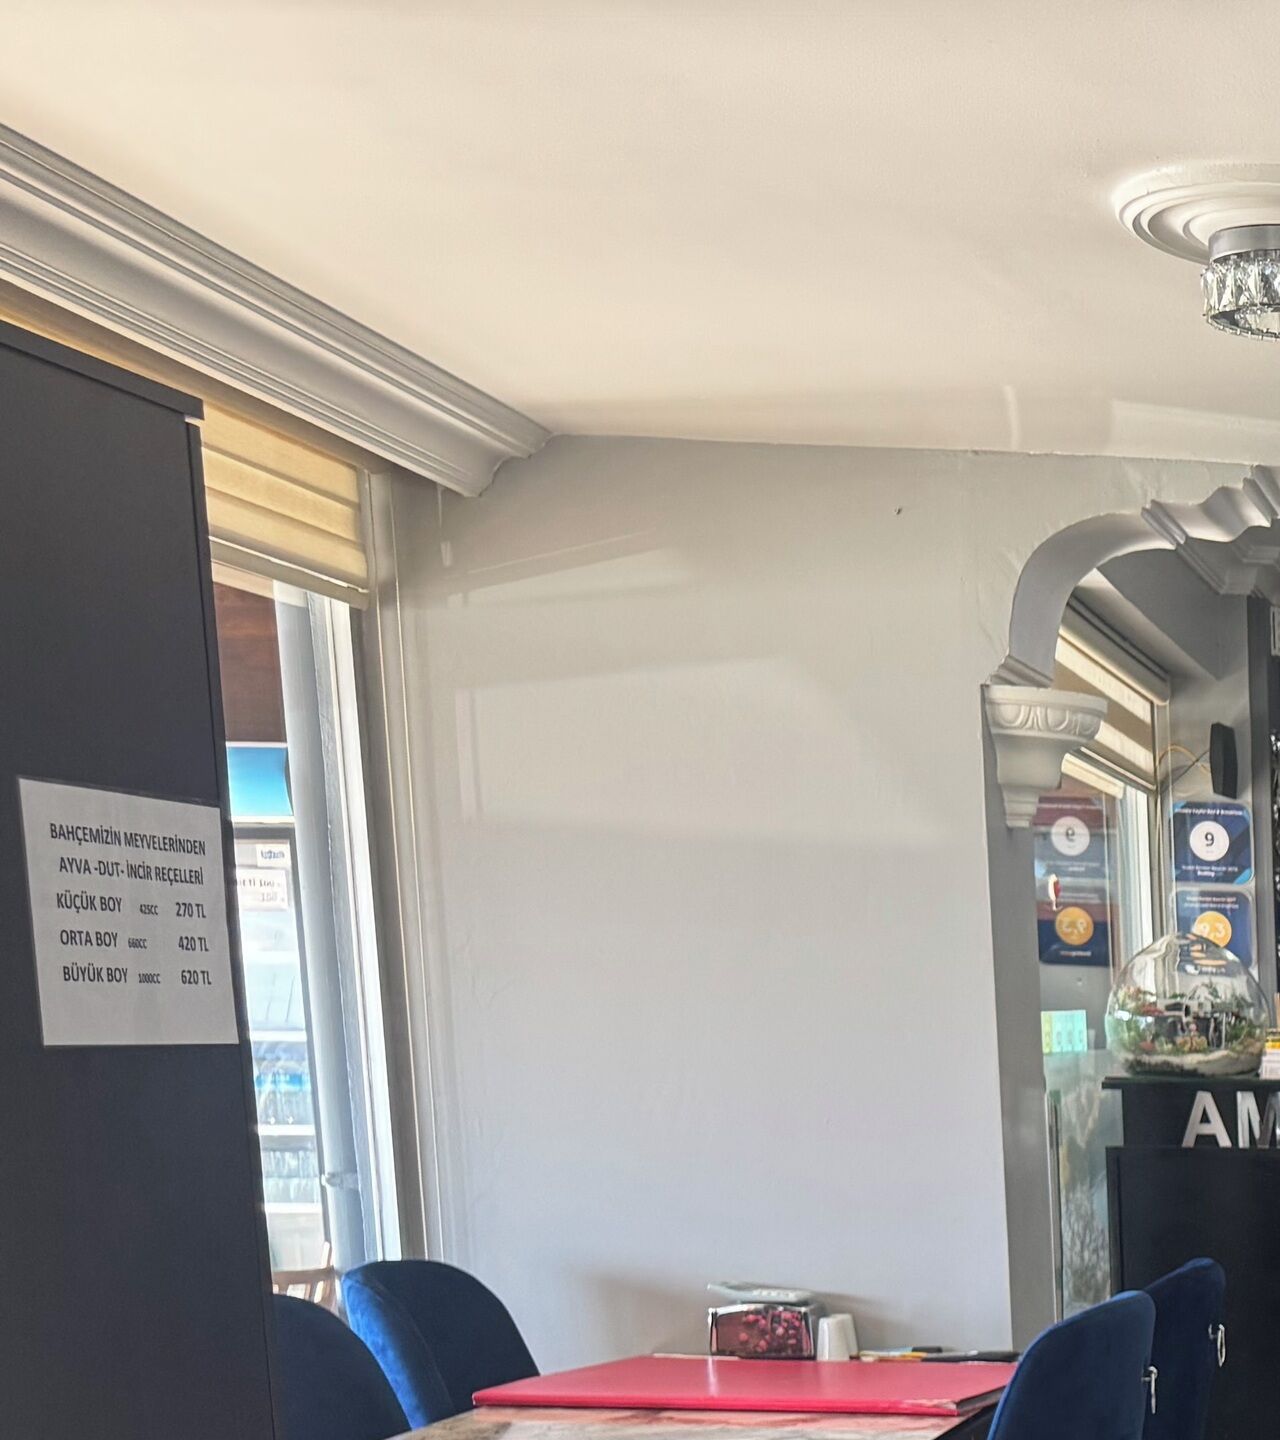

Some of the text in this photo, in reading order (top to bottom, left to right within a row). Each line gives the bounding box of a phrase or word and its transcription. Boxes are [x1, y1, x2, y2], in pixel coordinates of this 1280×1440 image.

[50, 823, 206, 856] BAHÇEMİZİN MEYVELERİNDEN
[1204, 832, 1215, 847] 9
[59, 857, 91, 875] AYVA
[126, 860, 153, 881] İNCİR
[155, 866, 204, 886] REÇELLERİ
[56, 890, 97, 914] KÜÇÜK
[100, 896, 122, 913] BOY
[175, 902, 194, 918] 270
[195, 904, 207, 918] TL
[60, 929, 93, 947] ORTA
[95, 931, 118, 948] BOY
[178, 936, 197, 951] 420
[197, 937, 209, 952] TL
[63, 962, 104, 983] BÜYÜK
[106, 967, 128, 984] BOY
[181, 970, 199, 985] 620
[200, 971, 212, 985] TL
